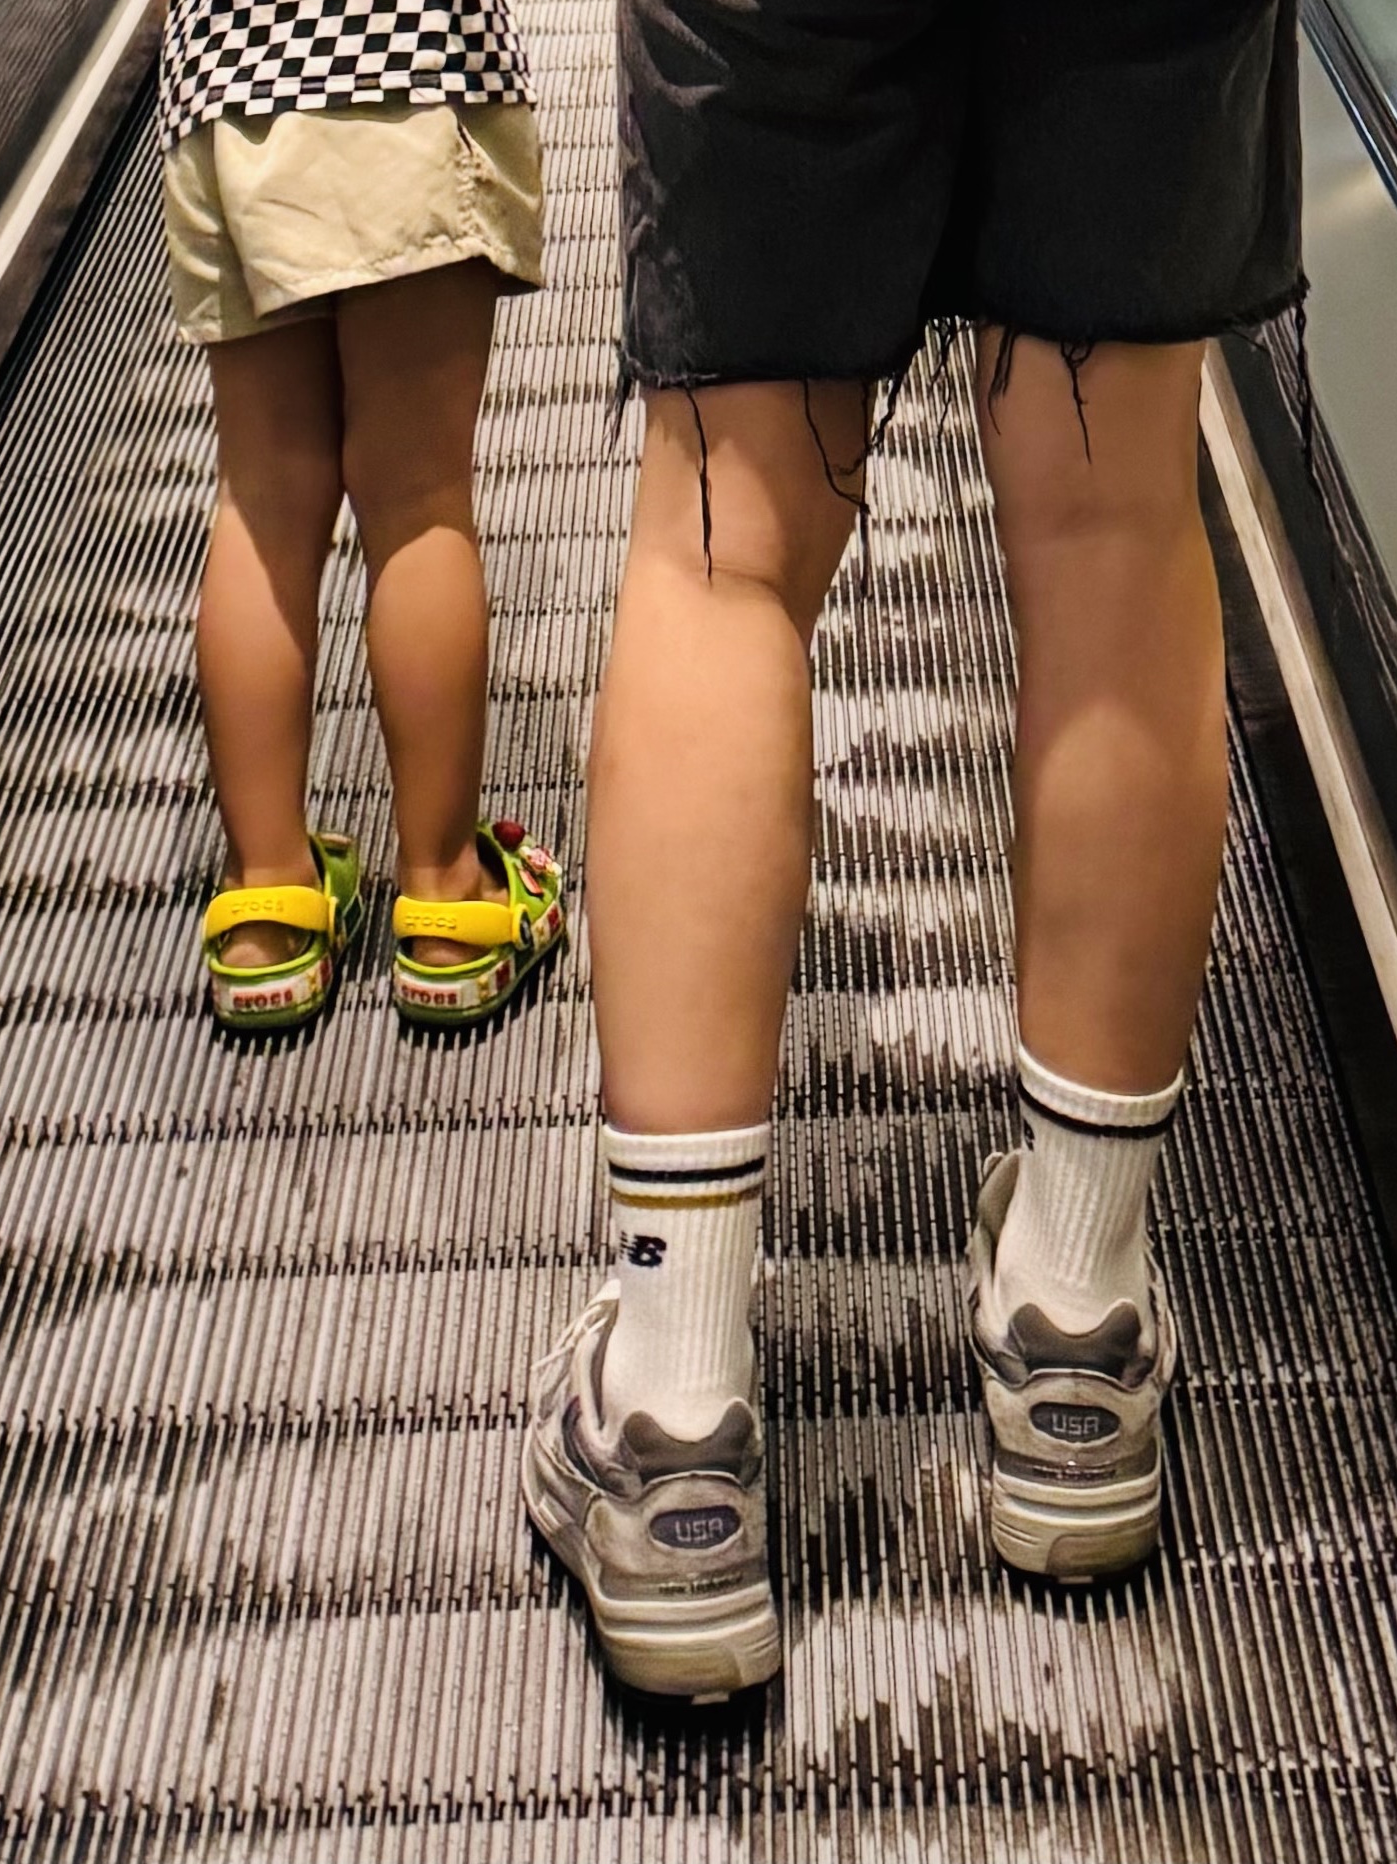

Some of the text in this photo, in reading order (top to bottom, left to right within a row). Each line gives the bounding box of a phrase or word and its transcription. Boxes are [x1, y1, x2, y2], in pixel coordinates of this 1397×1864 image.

[233, 988, 294, 1010] crocs
[1051, 1412, 1100, 1436] USA
[674, 1516, 725, 1543] USA
